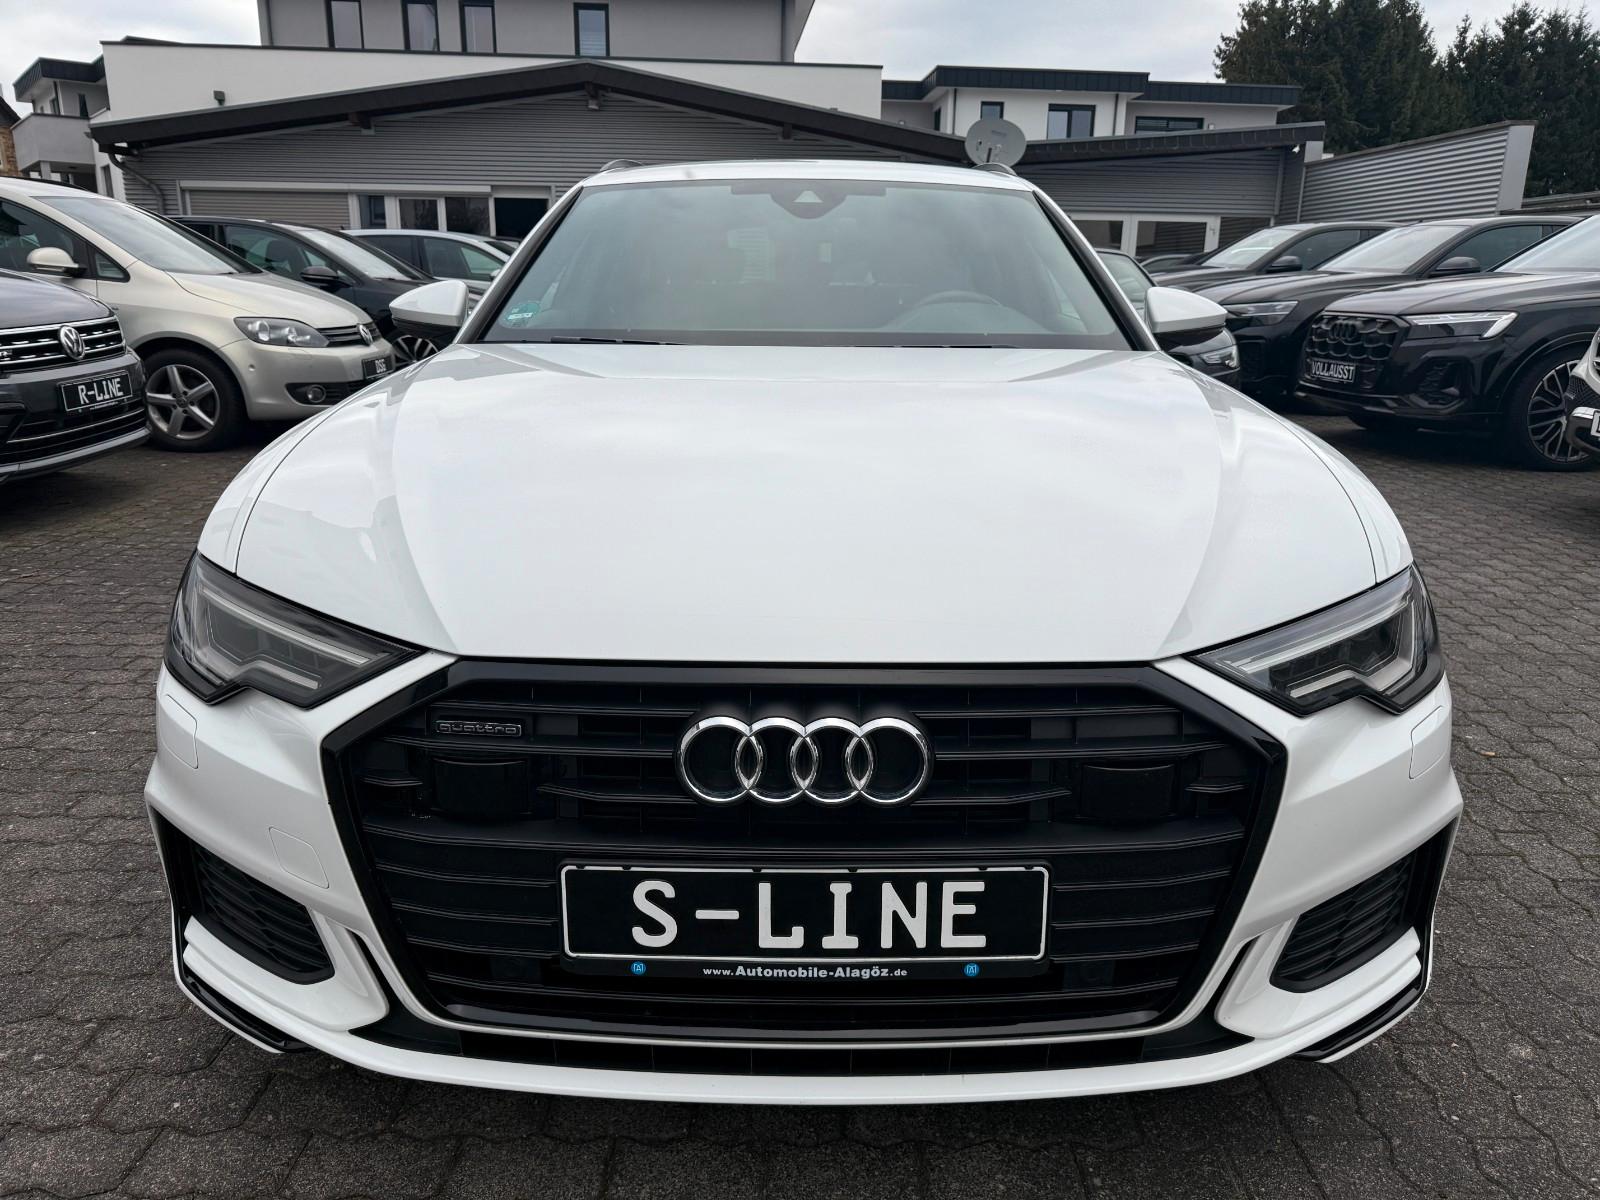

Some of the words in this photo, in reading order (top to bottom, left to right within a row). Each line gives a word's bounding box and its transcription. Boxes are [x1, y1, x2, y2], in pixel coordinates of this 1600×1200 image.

[1312, 361, 1354, 380] VOLLAUSST
[78, 378, 124, 404] R-LINE
[439, 723, 517, 735] quattro
[632, 880, 987, 949] S-LINE
[702, 965, 908, 979] www.Automobile-Alagöz.de
